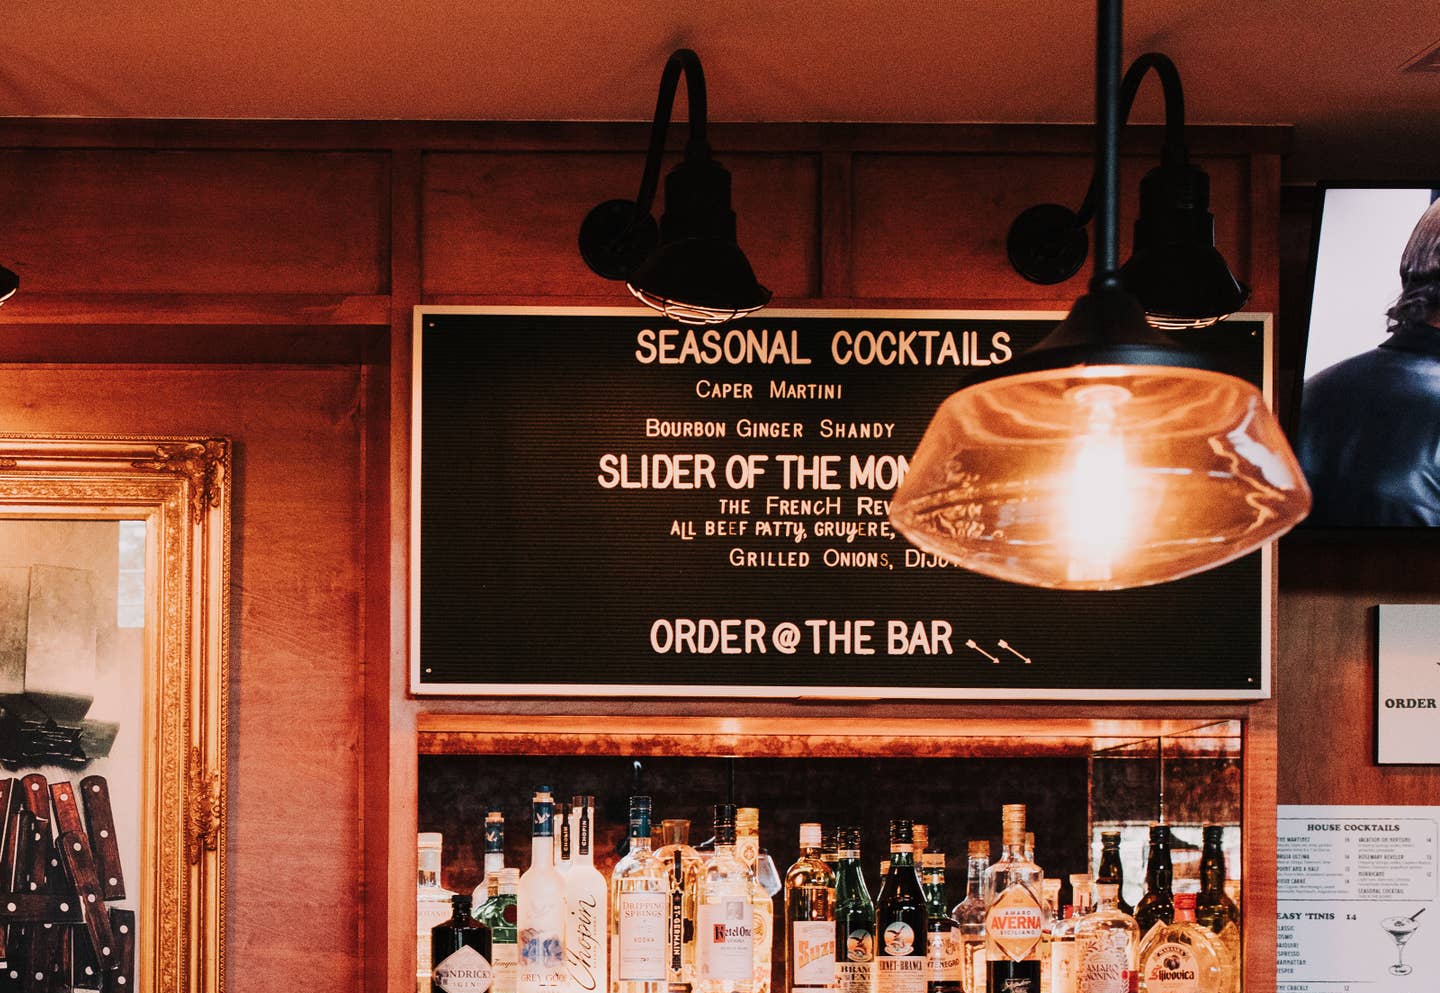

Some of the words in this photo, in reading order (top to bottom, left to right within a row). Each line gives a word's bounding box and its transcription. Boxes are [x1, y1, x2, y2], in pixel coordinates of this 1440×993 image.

[635, 329, 812, 365] SEASONAL
[831, 330, 1013, 367] COCKTAILS
[695, 379, 753, 399] CAPER
[769, 380, 842, 400] MARTINI
[646, 418, 726, 438] BOURBON
[736, 418, 803, 438] GINGER
[819, 419, 895, 439] SHANDY
[597, 453, 717, 490] SLIDER
[725, 454, 769, 490] OF
[775, 454, 842, 490] THE
[719, 499, 751, 515] THE
[766, 495, 841, 516] FRENCH
[670, 519, 697, 541] ALL
[705, 520, 749, 536] BEEF
[729, 547, 810, 568] GRILLED
[824, 548, 894, 570] ONIONS,
[650, 618, 767, 654] ORDER
[772, 622, 801, 654] @
[804, 619, 876, 655] THE
[887, 620, 953, 655] BAR
[1385, 698, 1437, 709] ORDER
[1307, 824, 1341, 832] HOUSE
[1344, 823, 1400, 832] COCKTAILS
[991, 916, 1041, 930] AVERNA
[1276, 912, 1302, 920] EASY
[568, 894, 597, 990] Chopin
[713, 924, 740, 943] Ketel
